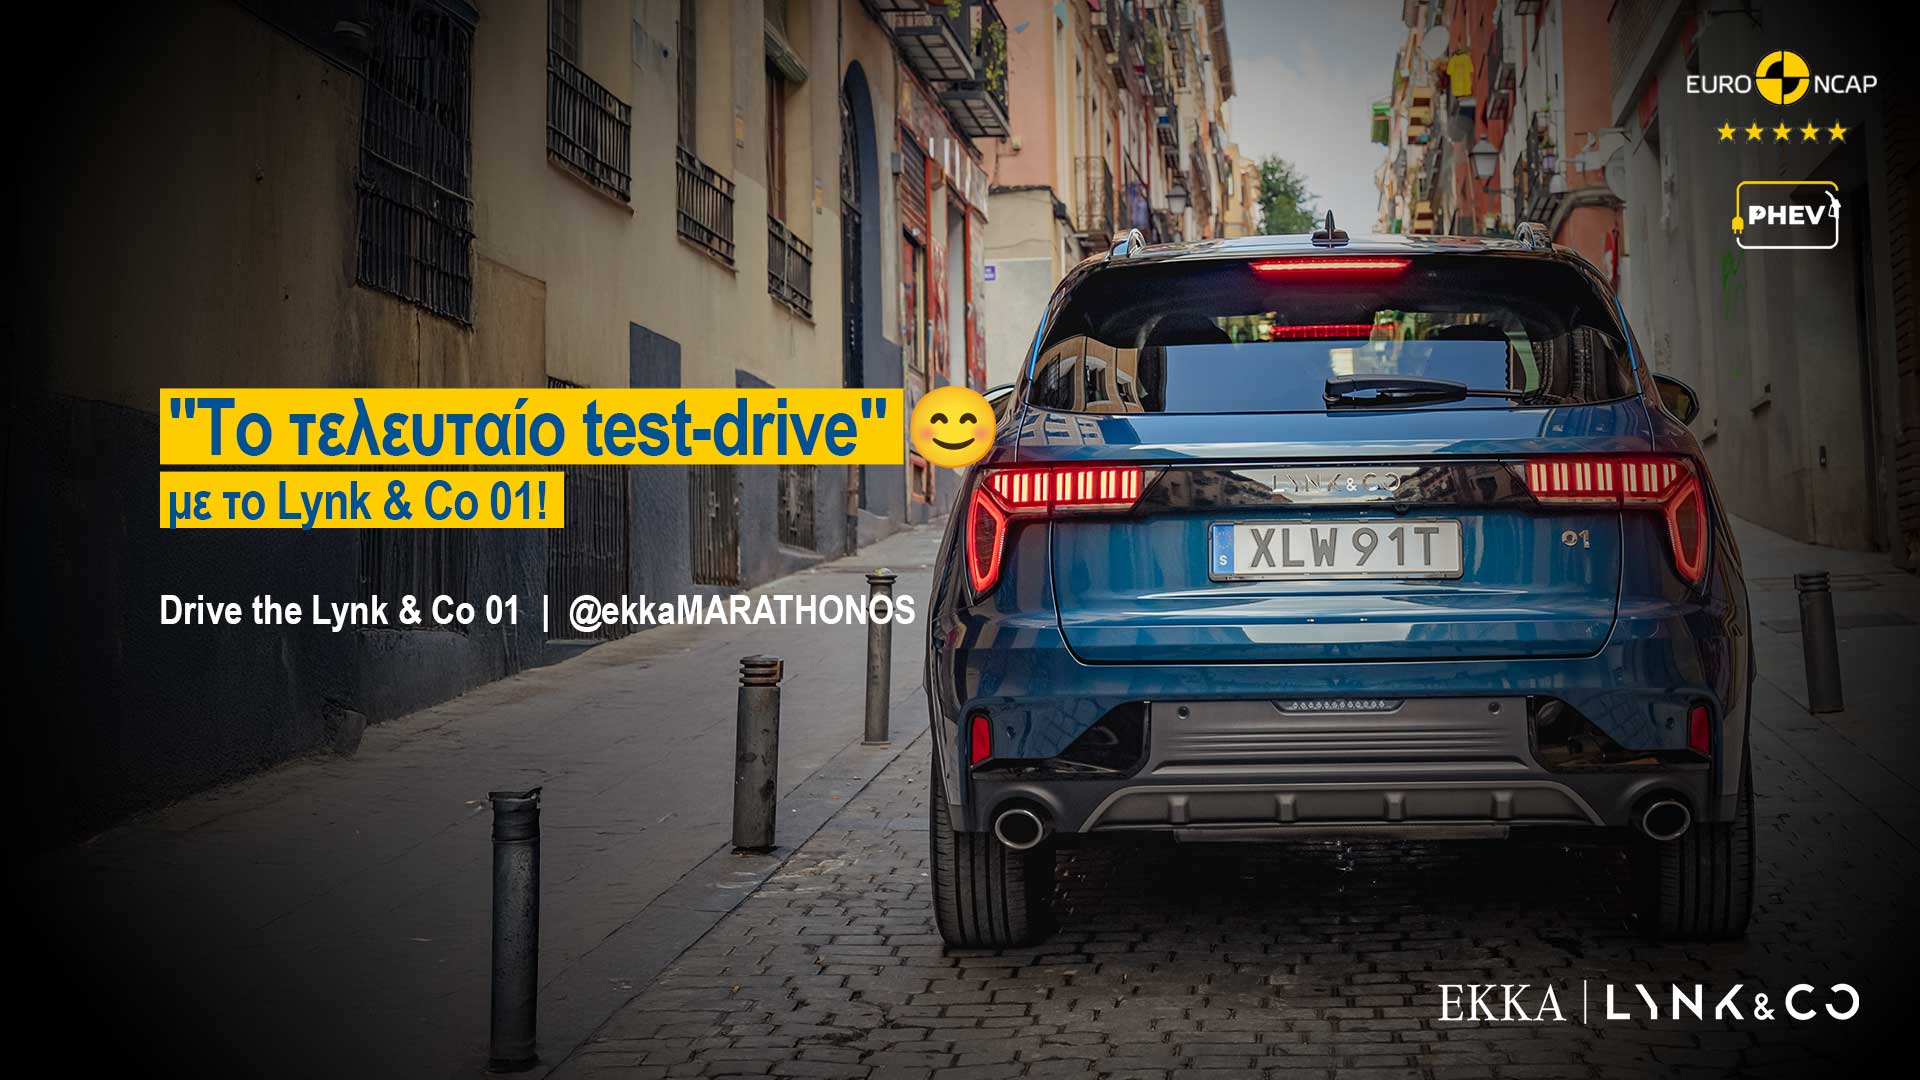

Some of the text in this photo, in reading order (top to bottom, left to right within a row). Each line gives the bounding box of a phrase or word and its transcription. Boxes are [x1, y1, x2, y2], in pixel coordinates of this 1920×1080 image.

[1250, 526, 1439, 568] XLW 91T
[1561, 529, 1590, 548] 01
[1219, 554, 1228, 566] S
